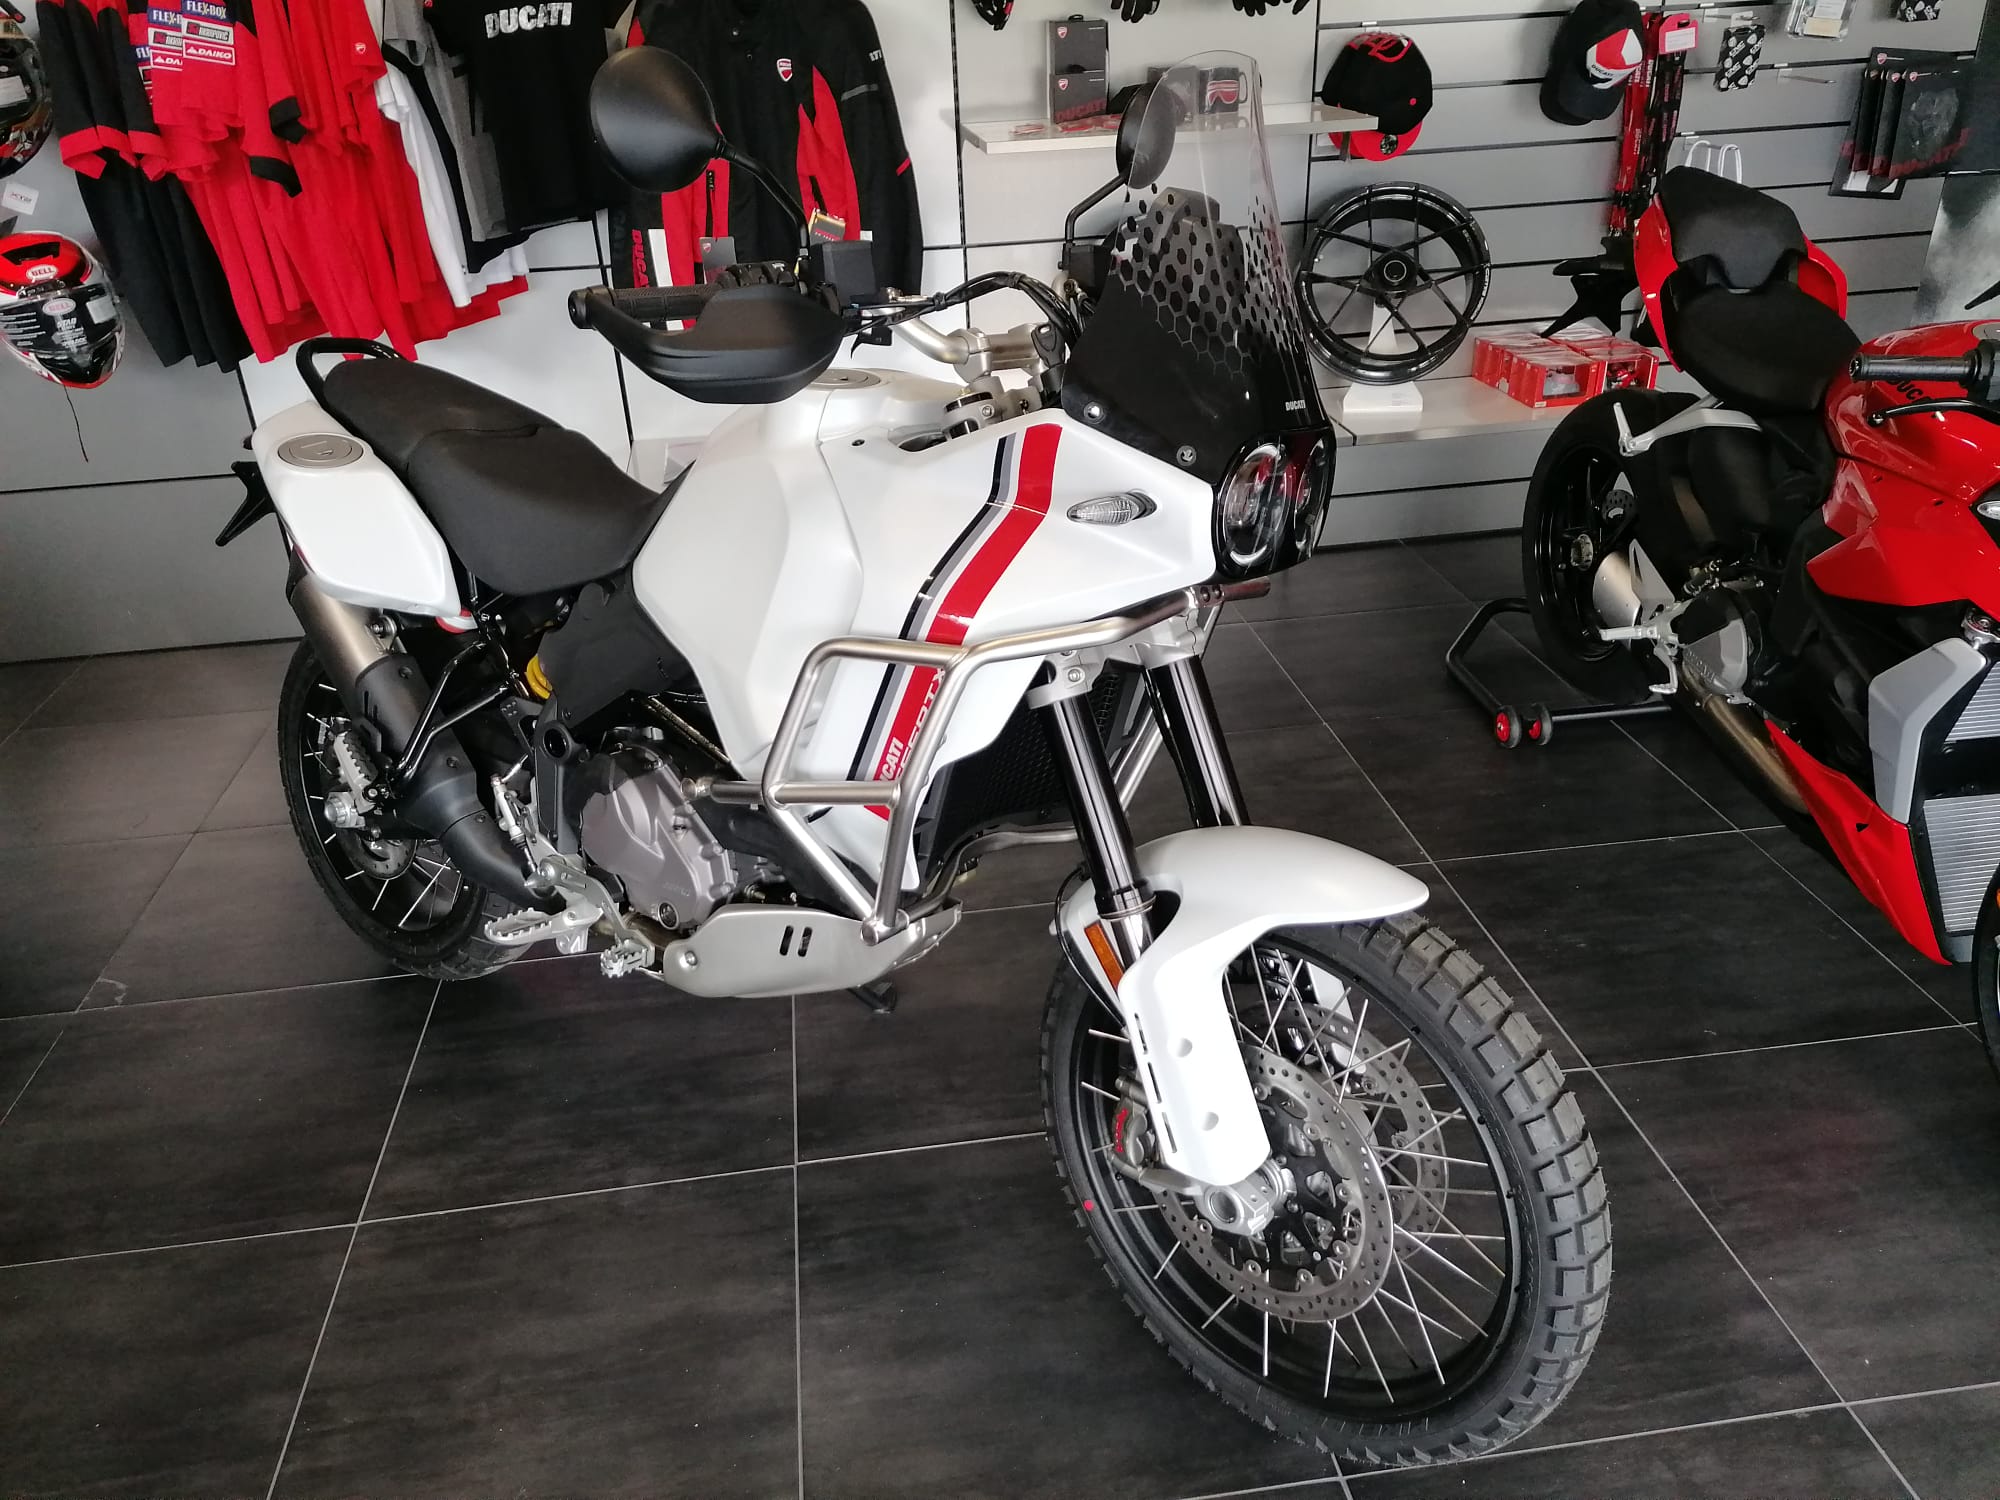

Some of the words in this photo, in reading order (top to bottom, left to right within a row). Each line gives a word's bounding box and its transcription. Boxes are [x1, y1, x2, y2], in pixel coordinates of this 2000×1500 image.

[186, 0, 227, 19] FLEX-BOX
[484, 2, 572, 39] DUCATI
[198, 47, 232, 60] DAIKO
[30, 267, 55, 279] BELL
[1285, 400, 1306, 411] DUCATI
